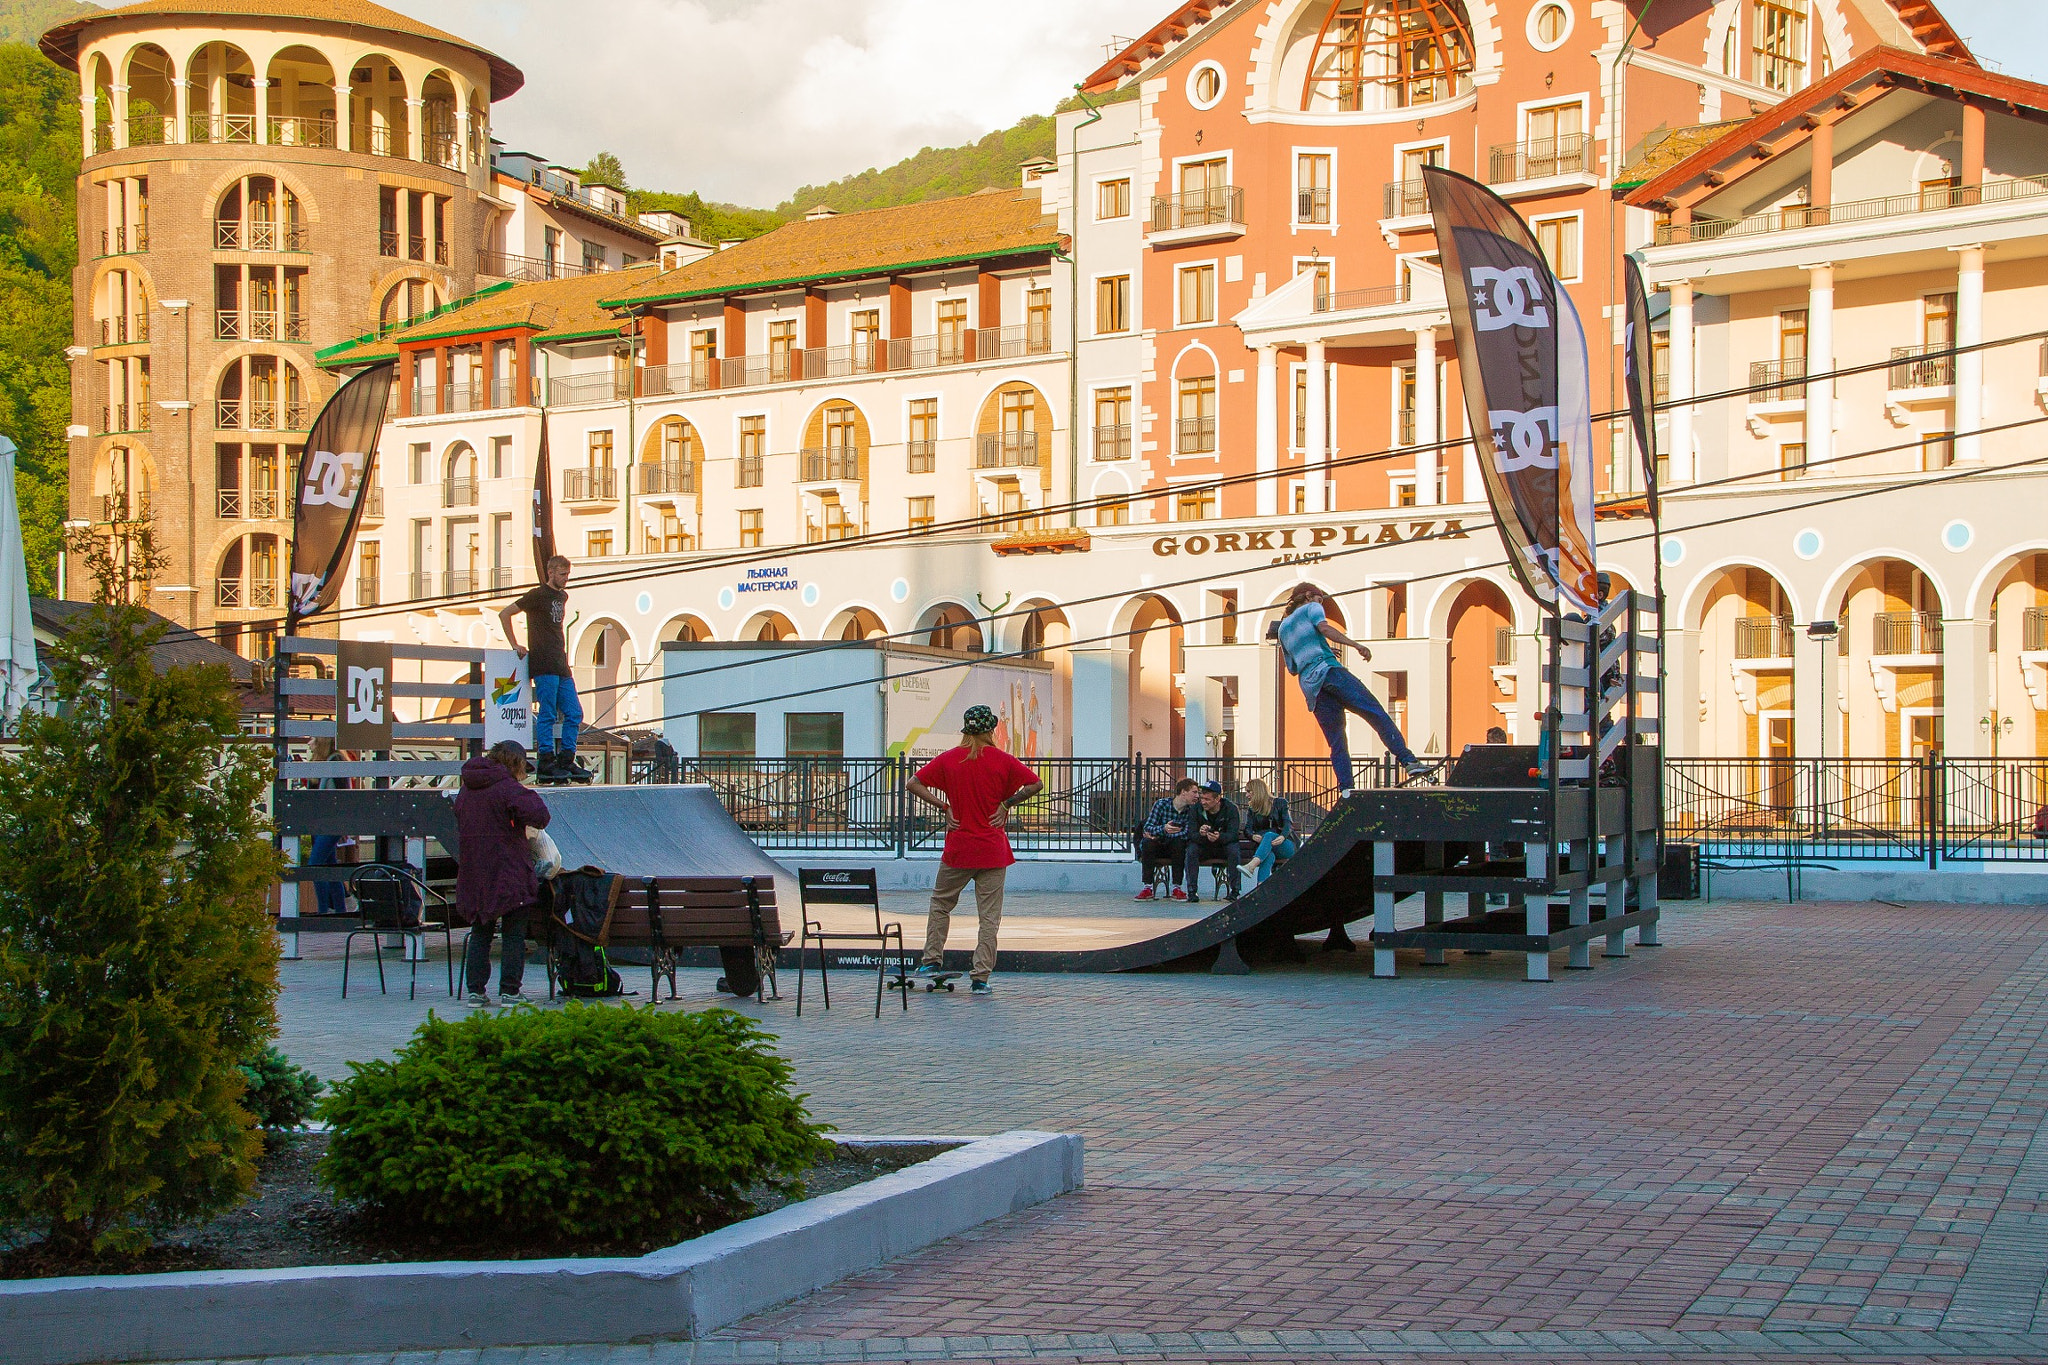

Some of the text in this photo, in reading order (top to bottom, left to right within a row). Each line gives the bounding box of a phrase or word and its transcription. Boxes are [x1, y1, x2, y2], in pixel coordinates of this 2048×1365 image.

[1152, 519, 1471, 557] GORKI PLAZA
[1283, 551, 1321, 566] EAST
[747, 567, 788, 579] ЛЫЖНАЯ
[737, 580, 798, 593] МАСТЕРСКАЯ
[501, 707, 527, 725] горки
[837, 954, 914, 967] www.fk-rampsru
